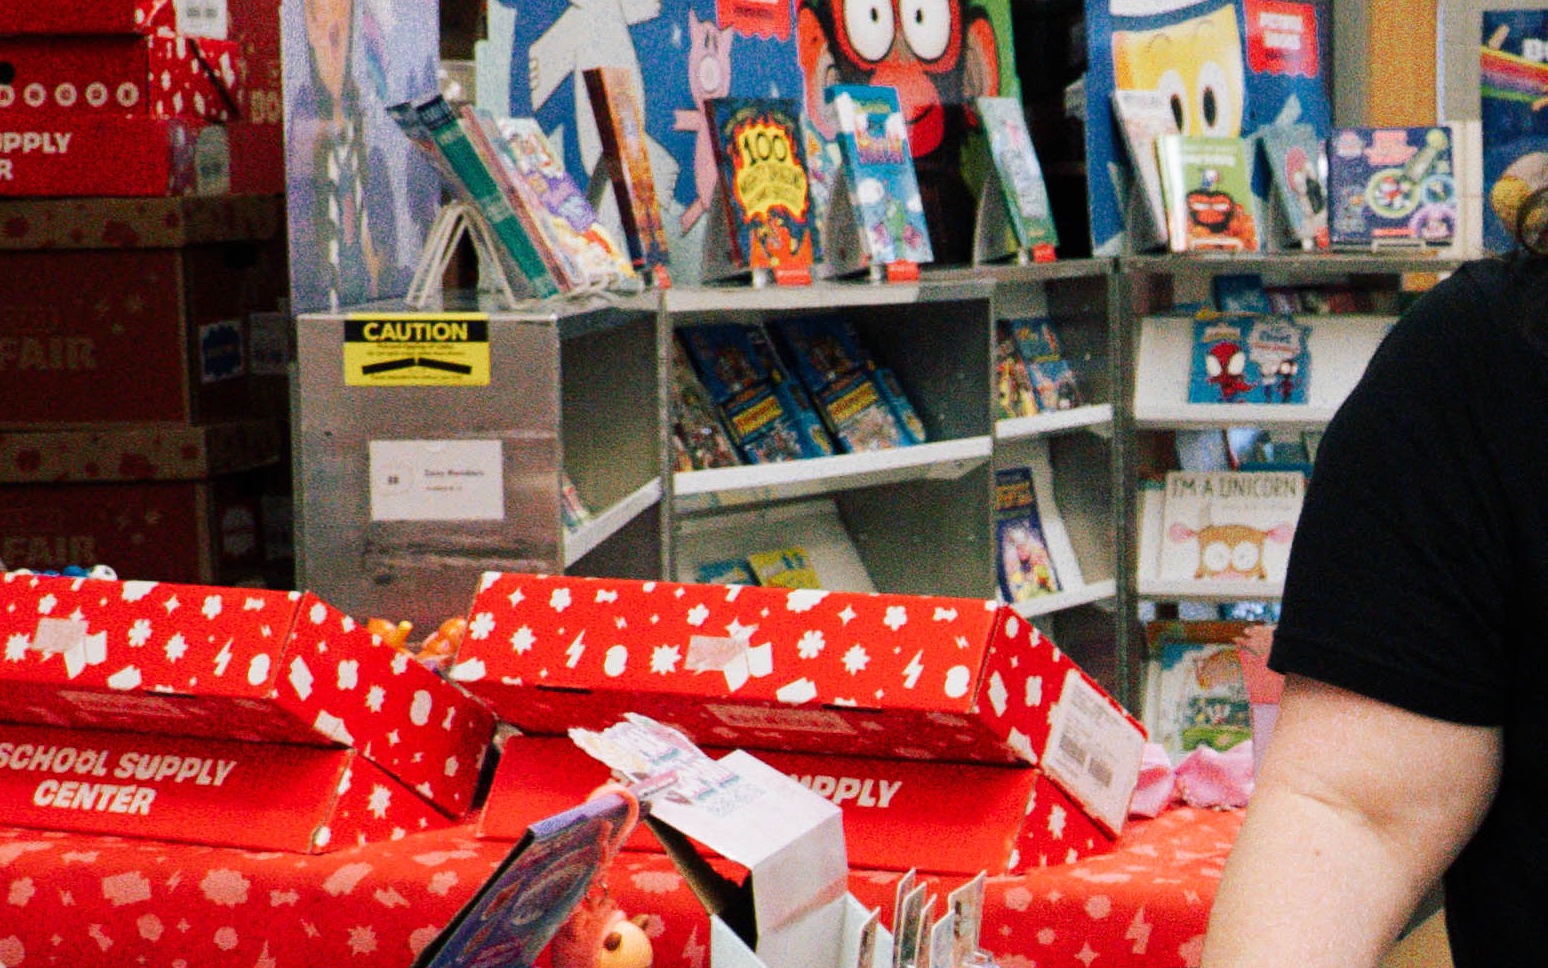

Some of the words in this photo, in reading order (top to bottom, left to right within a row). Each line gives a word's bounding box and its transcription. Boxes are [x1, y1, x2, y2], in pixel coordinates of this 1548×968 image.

[363, 322, 468, 341] CAUTION
[113, 754, 237, 788] SUPPLY
[32, 778, 158, 817] CENTER
